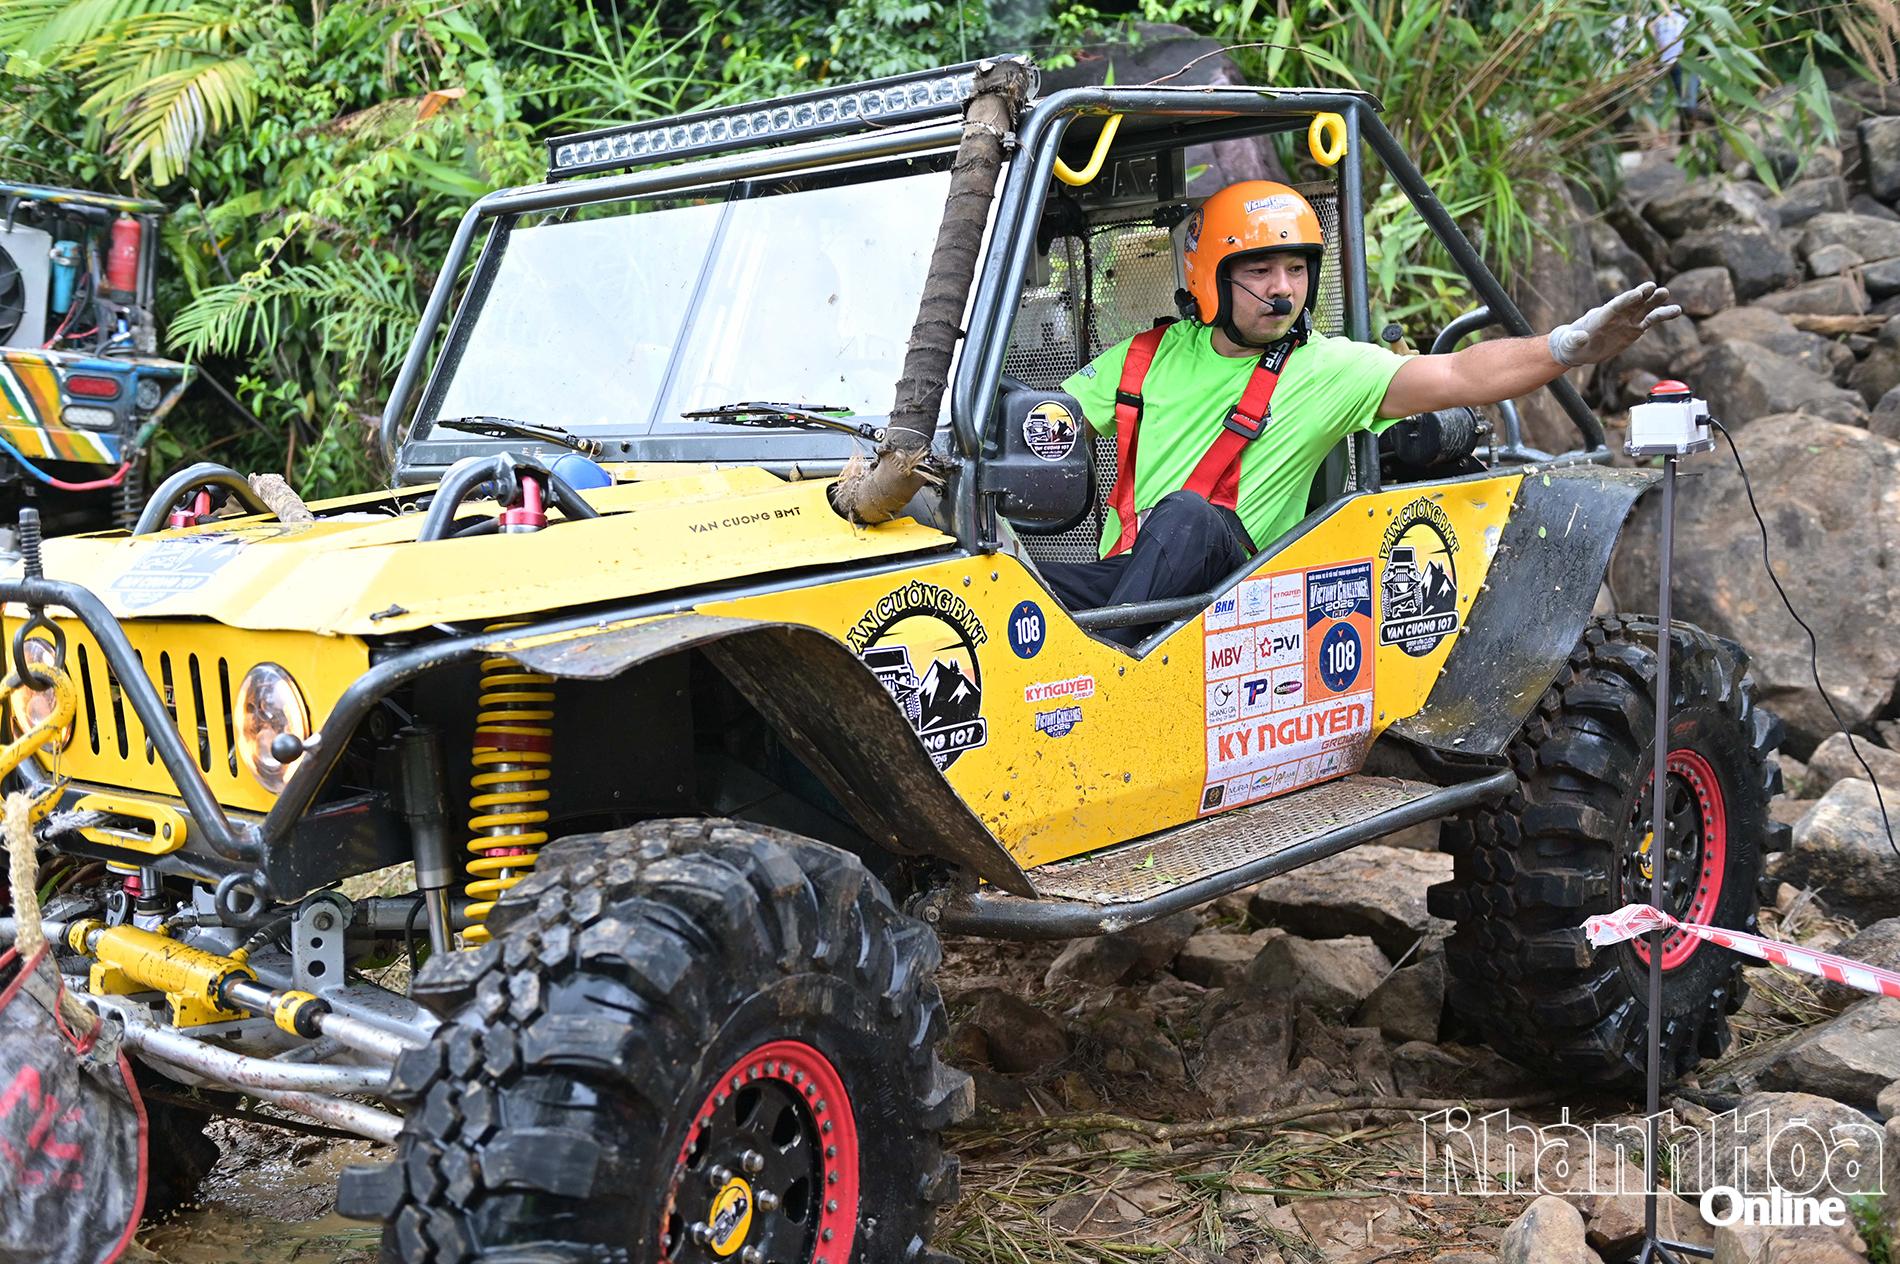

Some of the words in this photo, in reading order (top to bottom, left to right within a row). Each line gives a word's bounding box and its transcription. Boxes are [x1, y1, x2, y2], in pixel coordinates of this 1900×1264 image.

[689, 521, 719, 533] VAN
[722, 512, 771, 528] CUONG
[774, 506, 801, 519] BMT
[1325, 599, 1355, 612] 2026
[1015, 615, 1040, 645] 108
[1387, 625, 1404, 640] VAN
[1405, 620, 1436, 637] CUONG
[1437, 617, 1453, 631] 107
[1273, 634, 1300, 653] PVI
[1211, 645, 1243, 670] MBV
[1327, 639, 1356, 675] 108
[950, 726, 975, 747] 107
